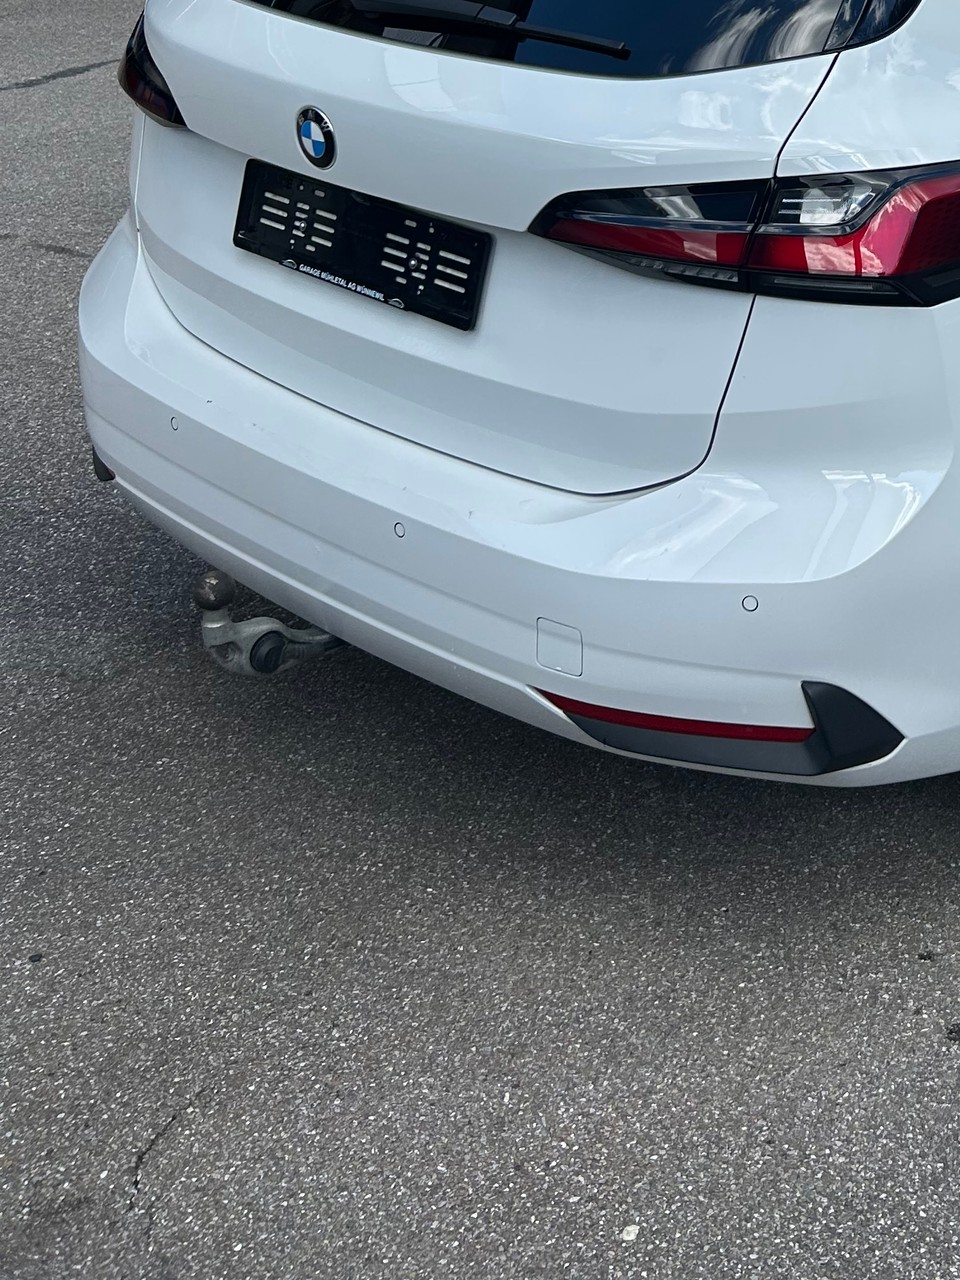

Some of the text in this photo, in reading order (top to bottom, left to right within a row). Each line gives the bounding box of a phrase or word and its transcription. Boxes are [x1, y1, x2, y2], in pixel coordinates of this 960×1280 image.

[299, 263, 321, 277] GARAGE
[320, 271, 347, 287] MÜHLETAL
[347, 281, 356, 290] AG
